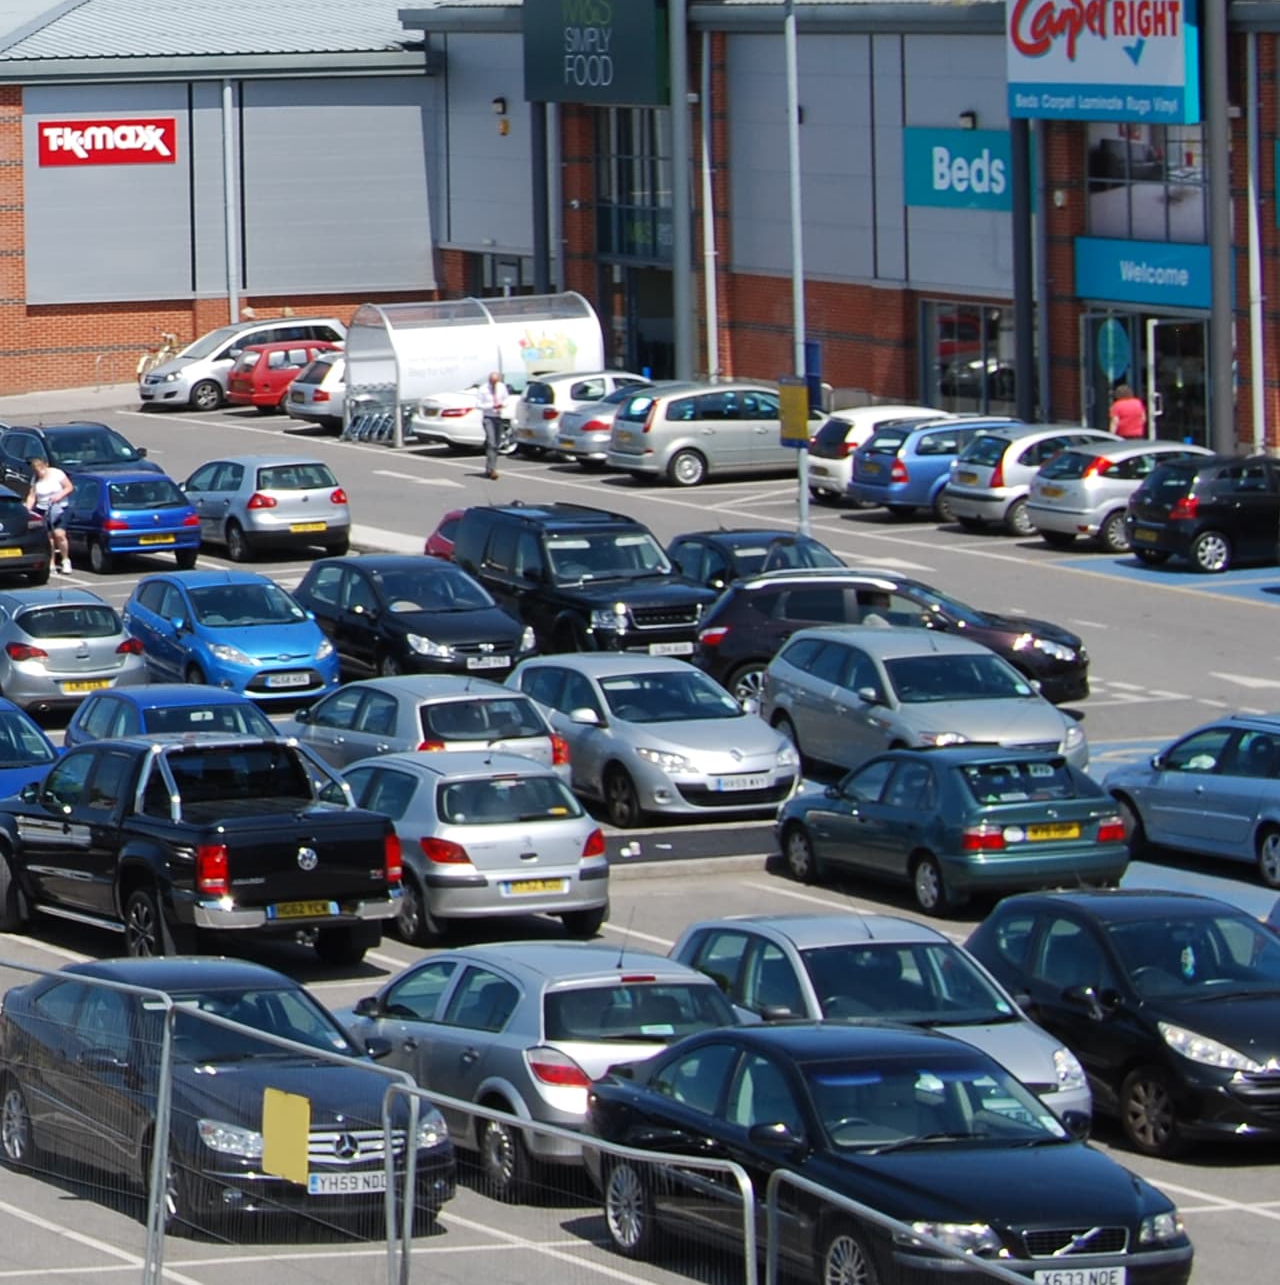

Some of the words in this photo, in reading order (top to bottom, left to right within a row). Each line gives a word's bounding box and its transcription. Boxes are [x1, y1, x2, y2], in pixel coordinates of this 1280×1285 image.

[564, 27, 612, 52] SIMPLY
[564, 55, 613, 86] FOOD
[1015, 93, 1038, 108] Beds
[1042, 94, 1076, 111] Carpet
[1079, 95, 1123, 110] Laminate
[1127, 96, 1151, 114] Rugs
[932, 146, 1006, 195] Beds
[1119, 259, 1189, 288] Welcome
[320, 1175, 357, 1191] YH59
